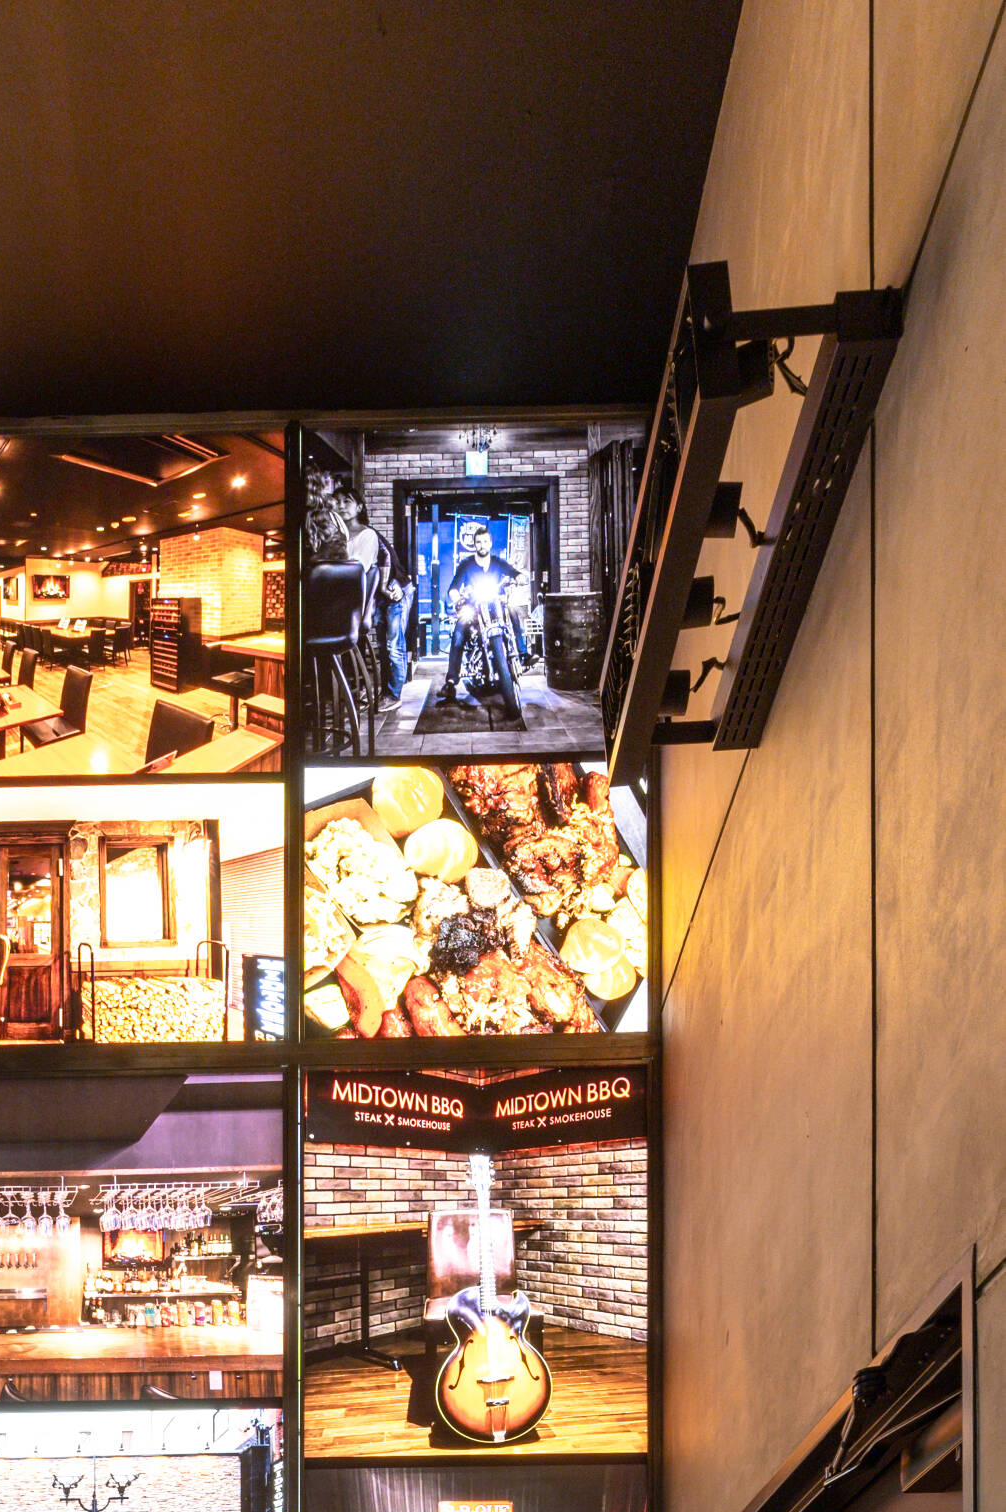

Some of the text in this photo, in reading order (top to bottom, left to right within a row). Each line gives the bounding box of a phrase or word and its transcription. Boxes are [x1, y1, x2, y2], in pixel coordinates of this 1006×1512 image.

[332, 1079, 464, 1118] MIDTOWN BBQ
[495, 1076, 631, 1118] MIDTOWN BBQ
[354, 1111, 383, 1124] STEAK
[397, 1116, 451, 1131] SMOKEHOUSE
[512, 1119, 535, 1131] STEAK
[549, 1107, 612, 1126] SMOKEHOUSE
